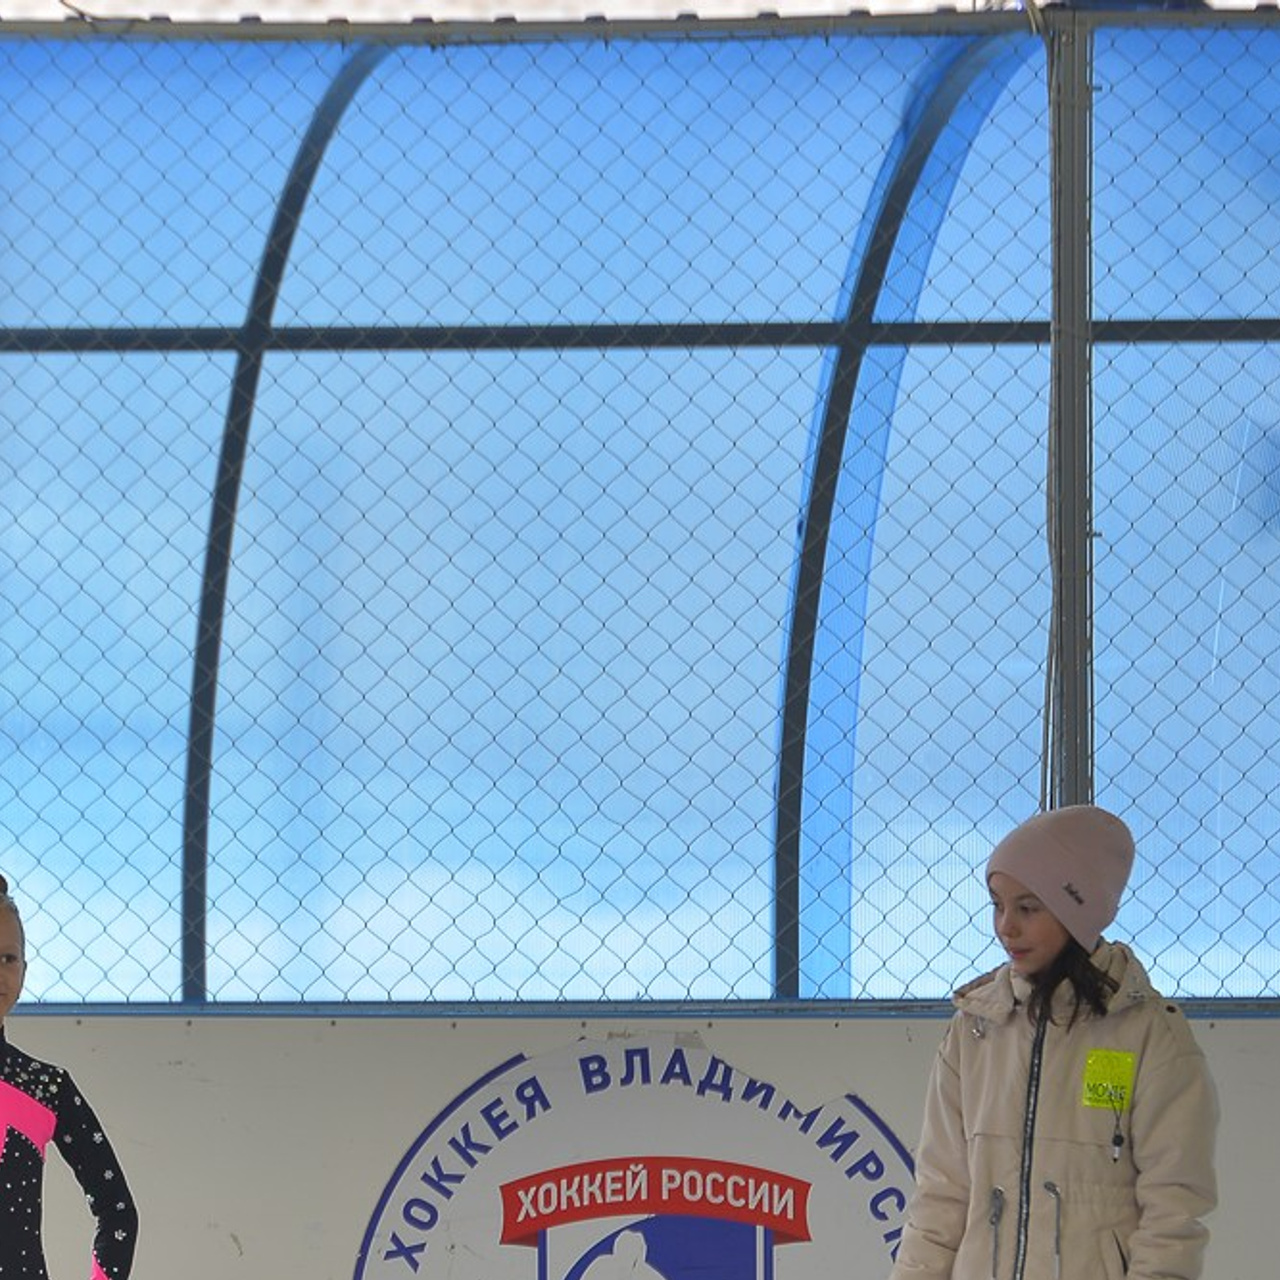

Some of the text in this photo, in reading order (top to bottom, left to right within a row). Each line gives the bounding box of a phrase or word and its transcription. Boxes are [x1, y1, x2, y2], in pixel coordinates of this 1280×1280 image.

[384, 1076, 551, 1272] ХОККЕЯ
[578, 1046, 907, 1264] ВЛАДИМИРС
[516, 1163, 795, 1223] ХОККЕЙ РОССИИ
